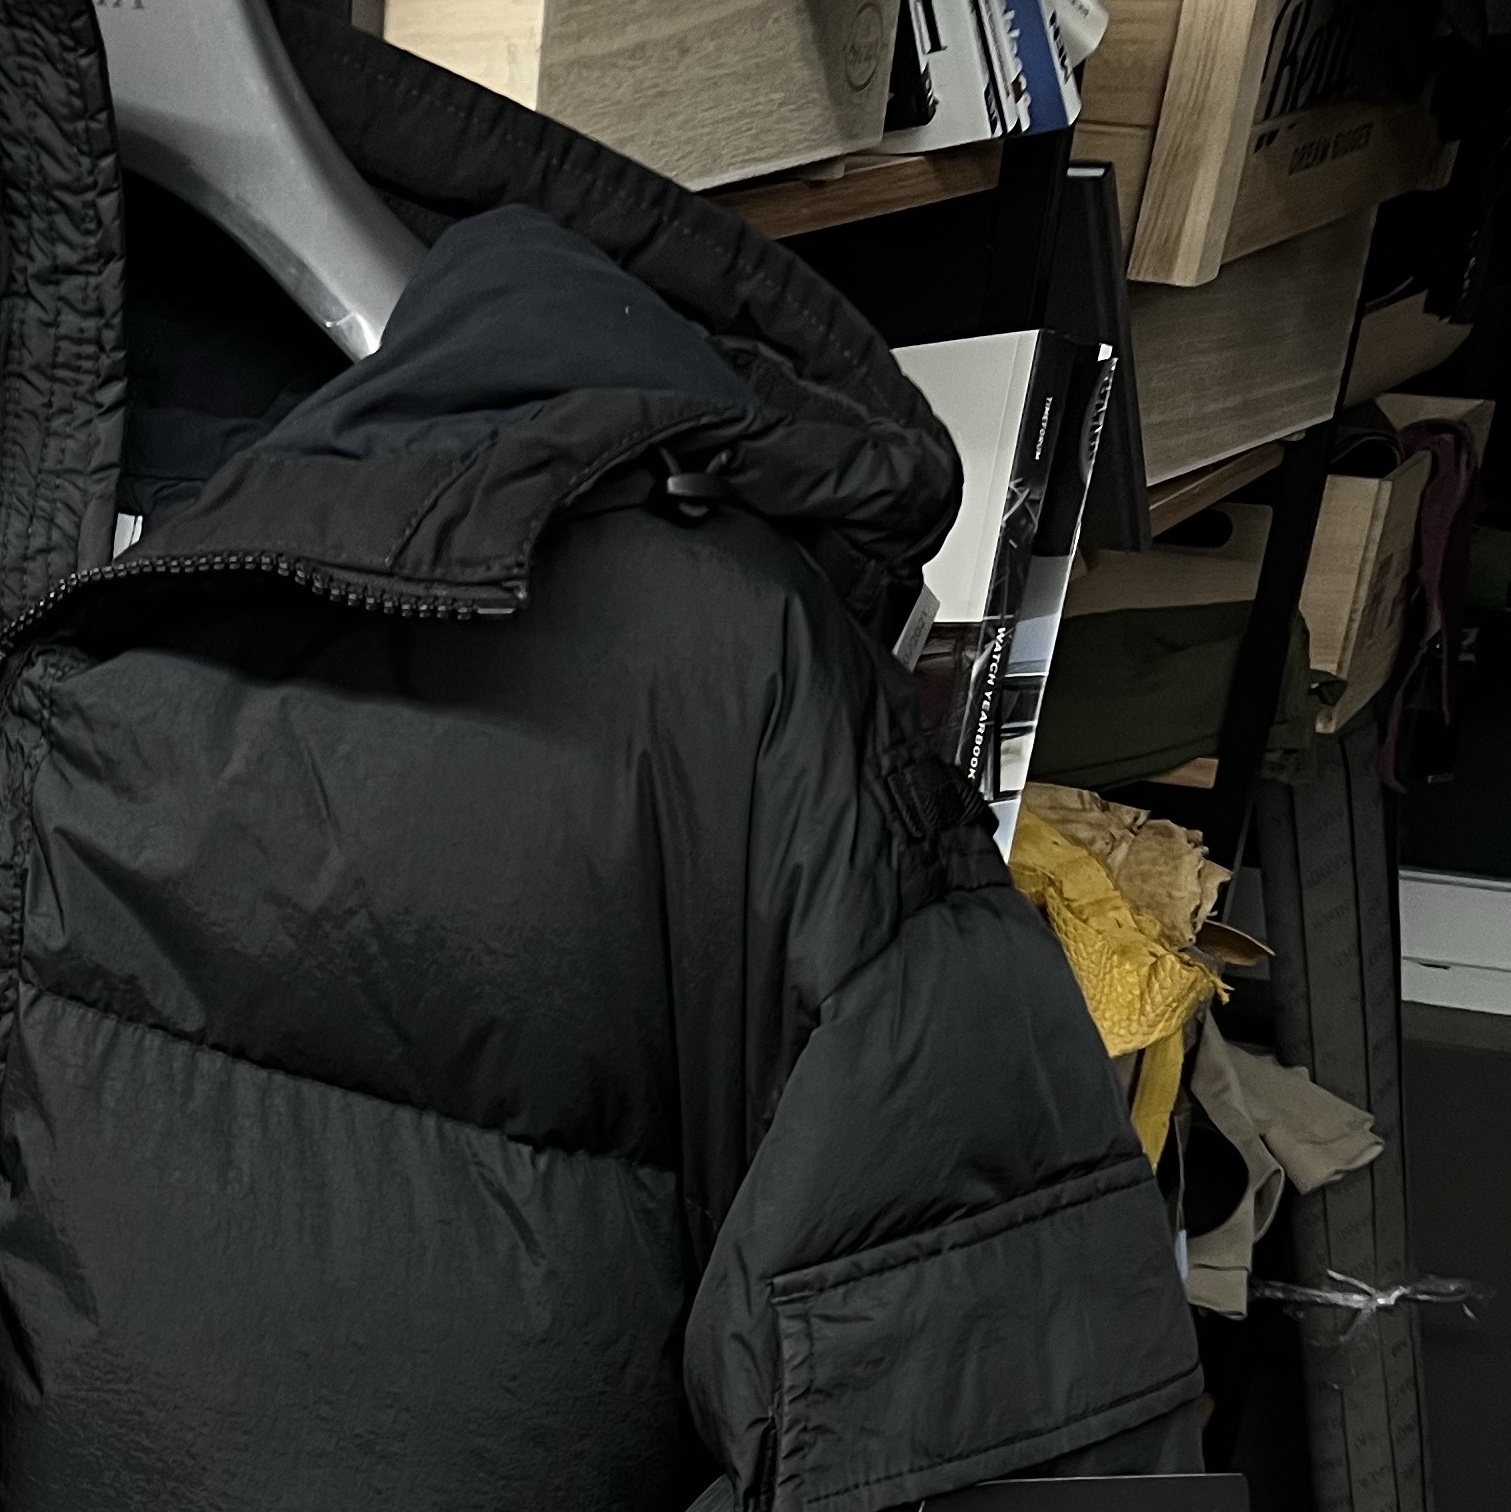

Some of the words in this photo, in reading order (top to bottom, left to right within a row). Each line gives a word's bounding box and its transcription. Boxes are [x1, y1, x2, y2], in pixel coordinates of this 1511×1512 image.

[1035, 397, 1053, 460] TIMEFORUM
[987, 627, 1006, 686] WATCH
[967, 690, 993, 780] YEARBOOK
